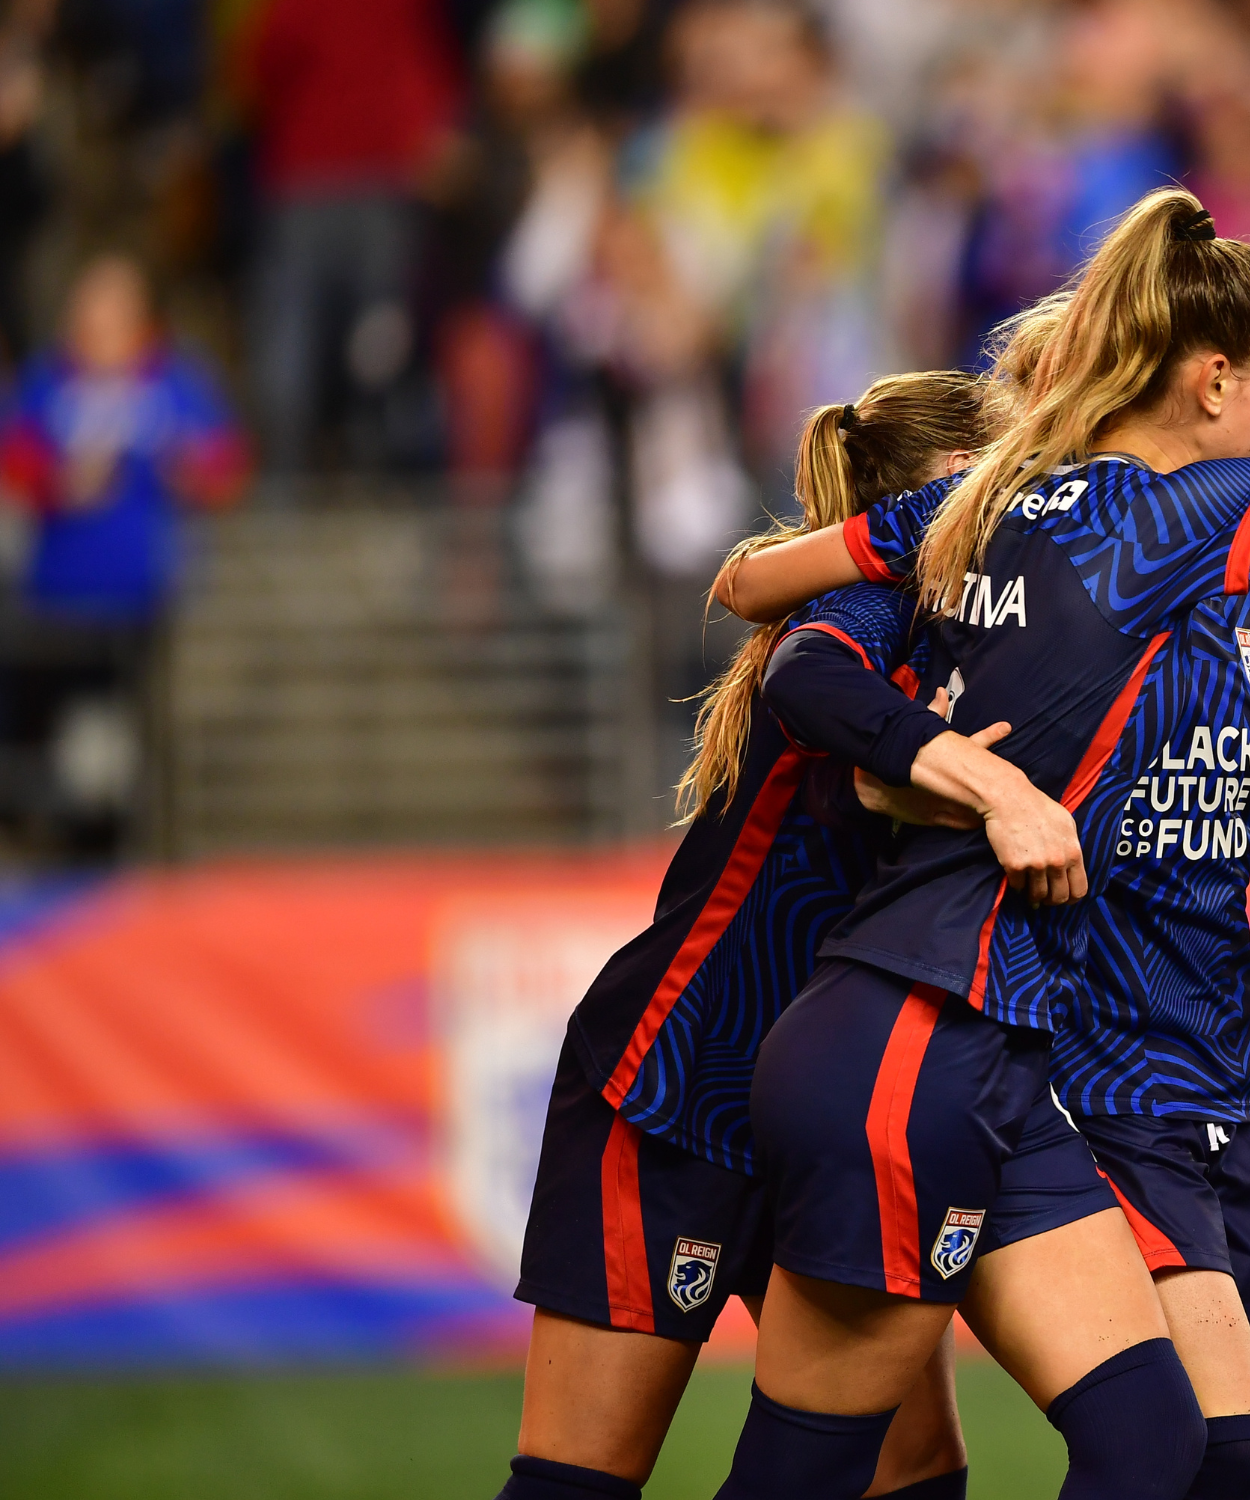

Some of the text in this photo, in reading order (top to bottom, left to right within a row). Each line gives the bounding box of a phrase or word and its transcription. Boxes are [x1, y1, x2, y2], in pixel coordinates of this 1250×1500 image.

[1121, 818, 1154, 837] CO
[1156, 818, 1248, 861] FUND
[1116, 840, 1151, 858] OP
[949, 1213, 981, 1225] OL REIGN
[679, 1242, 717, 1259] OL REIGN
